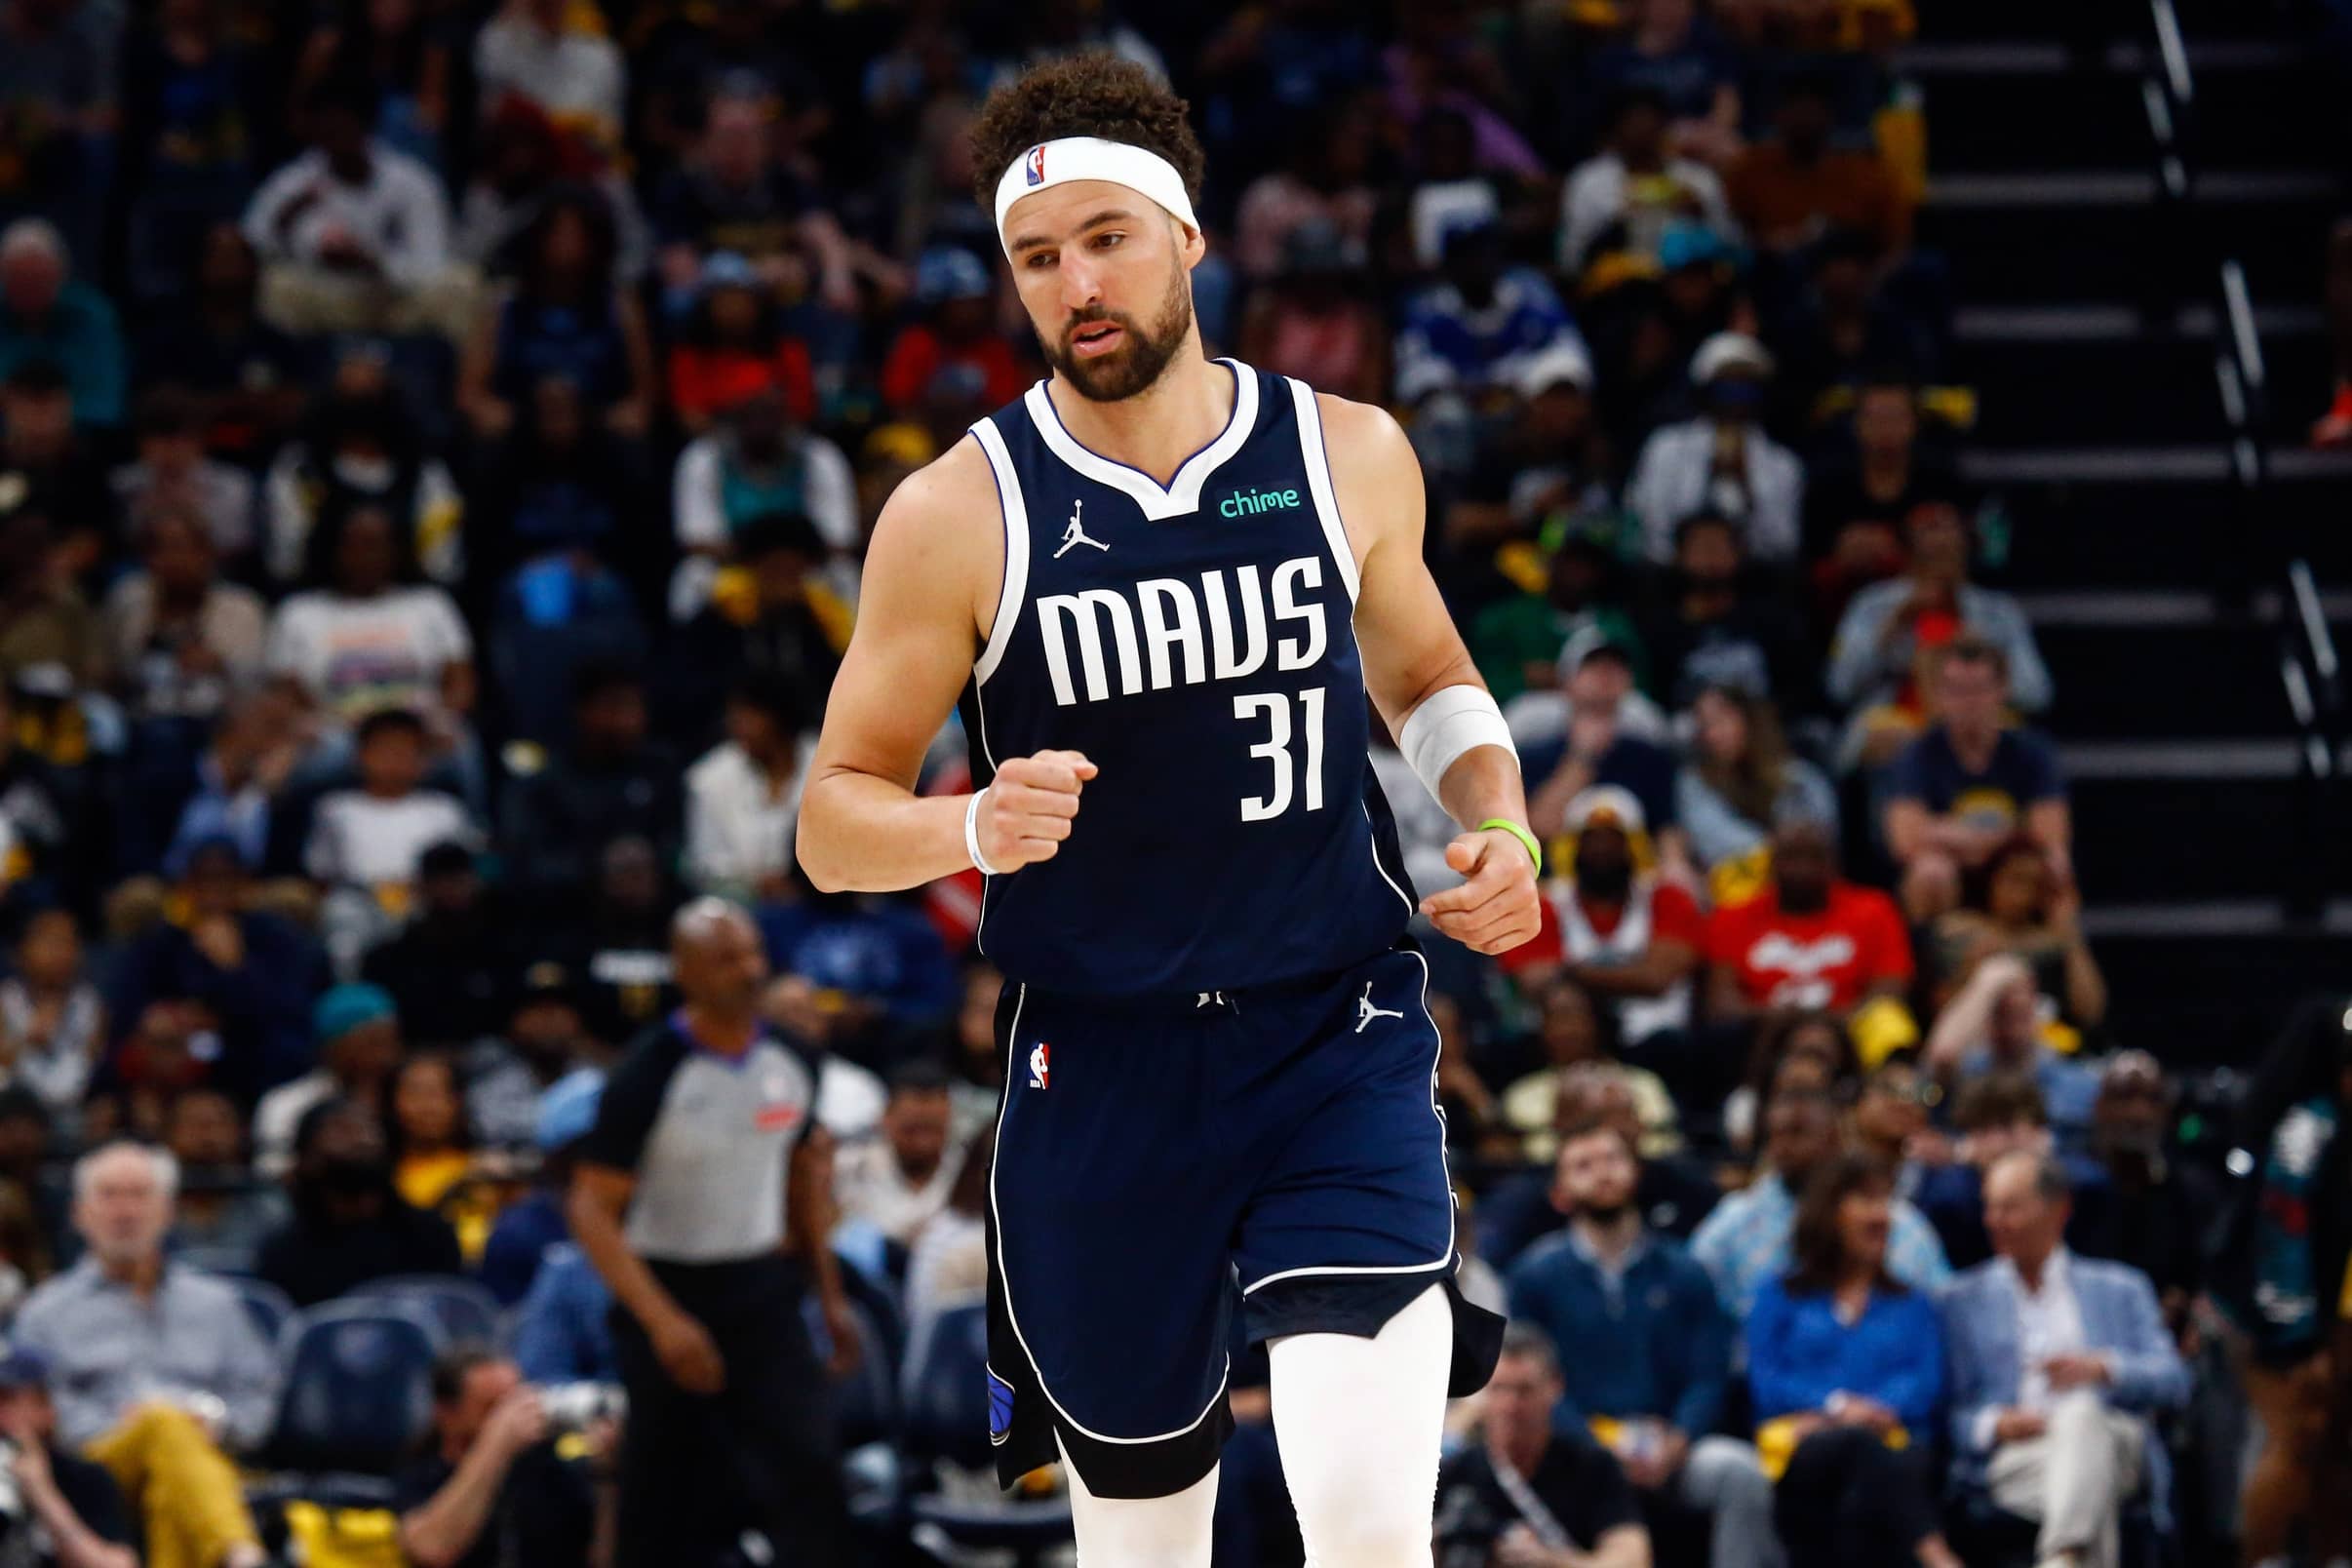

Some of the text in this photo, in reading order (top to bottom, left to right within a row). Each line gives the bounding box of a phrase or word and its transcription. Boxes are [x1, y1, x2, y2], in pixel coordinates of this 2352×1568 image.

[1220, 489, 1300, 518] chime
[1037, 557, 1327, 706] MAVS
[1234, 687, 1325, 822] 31
